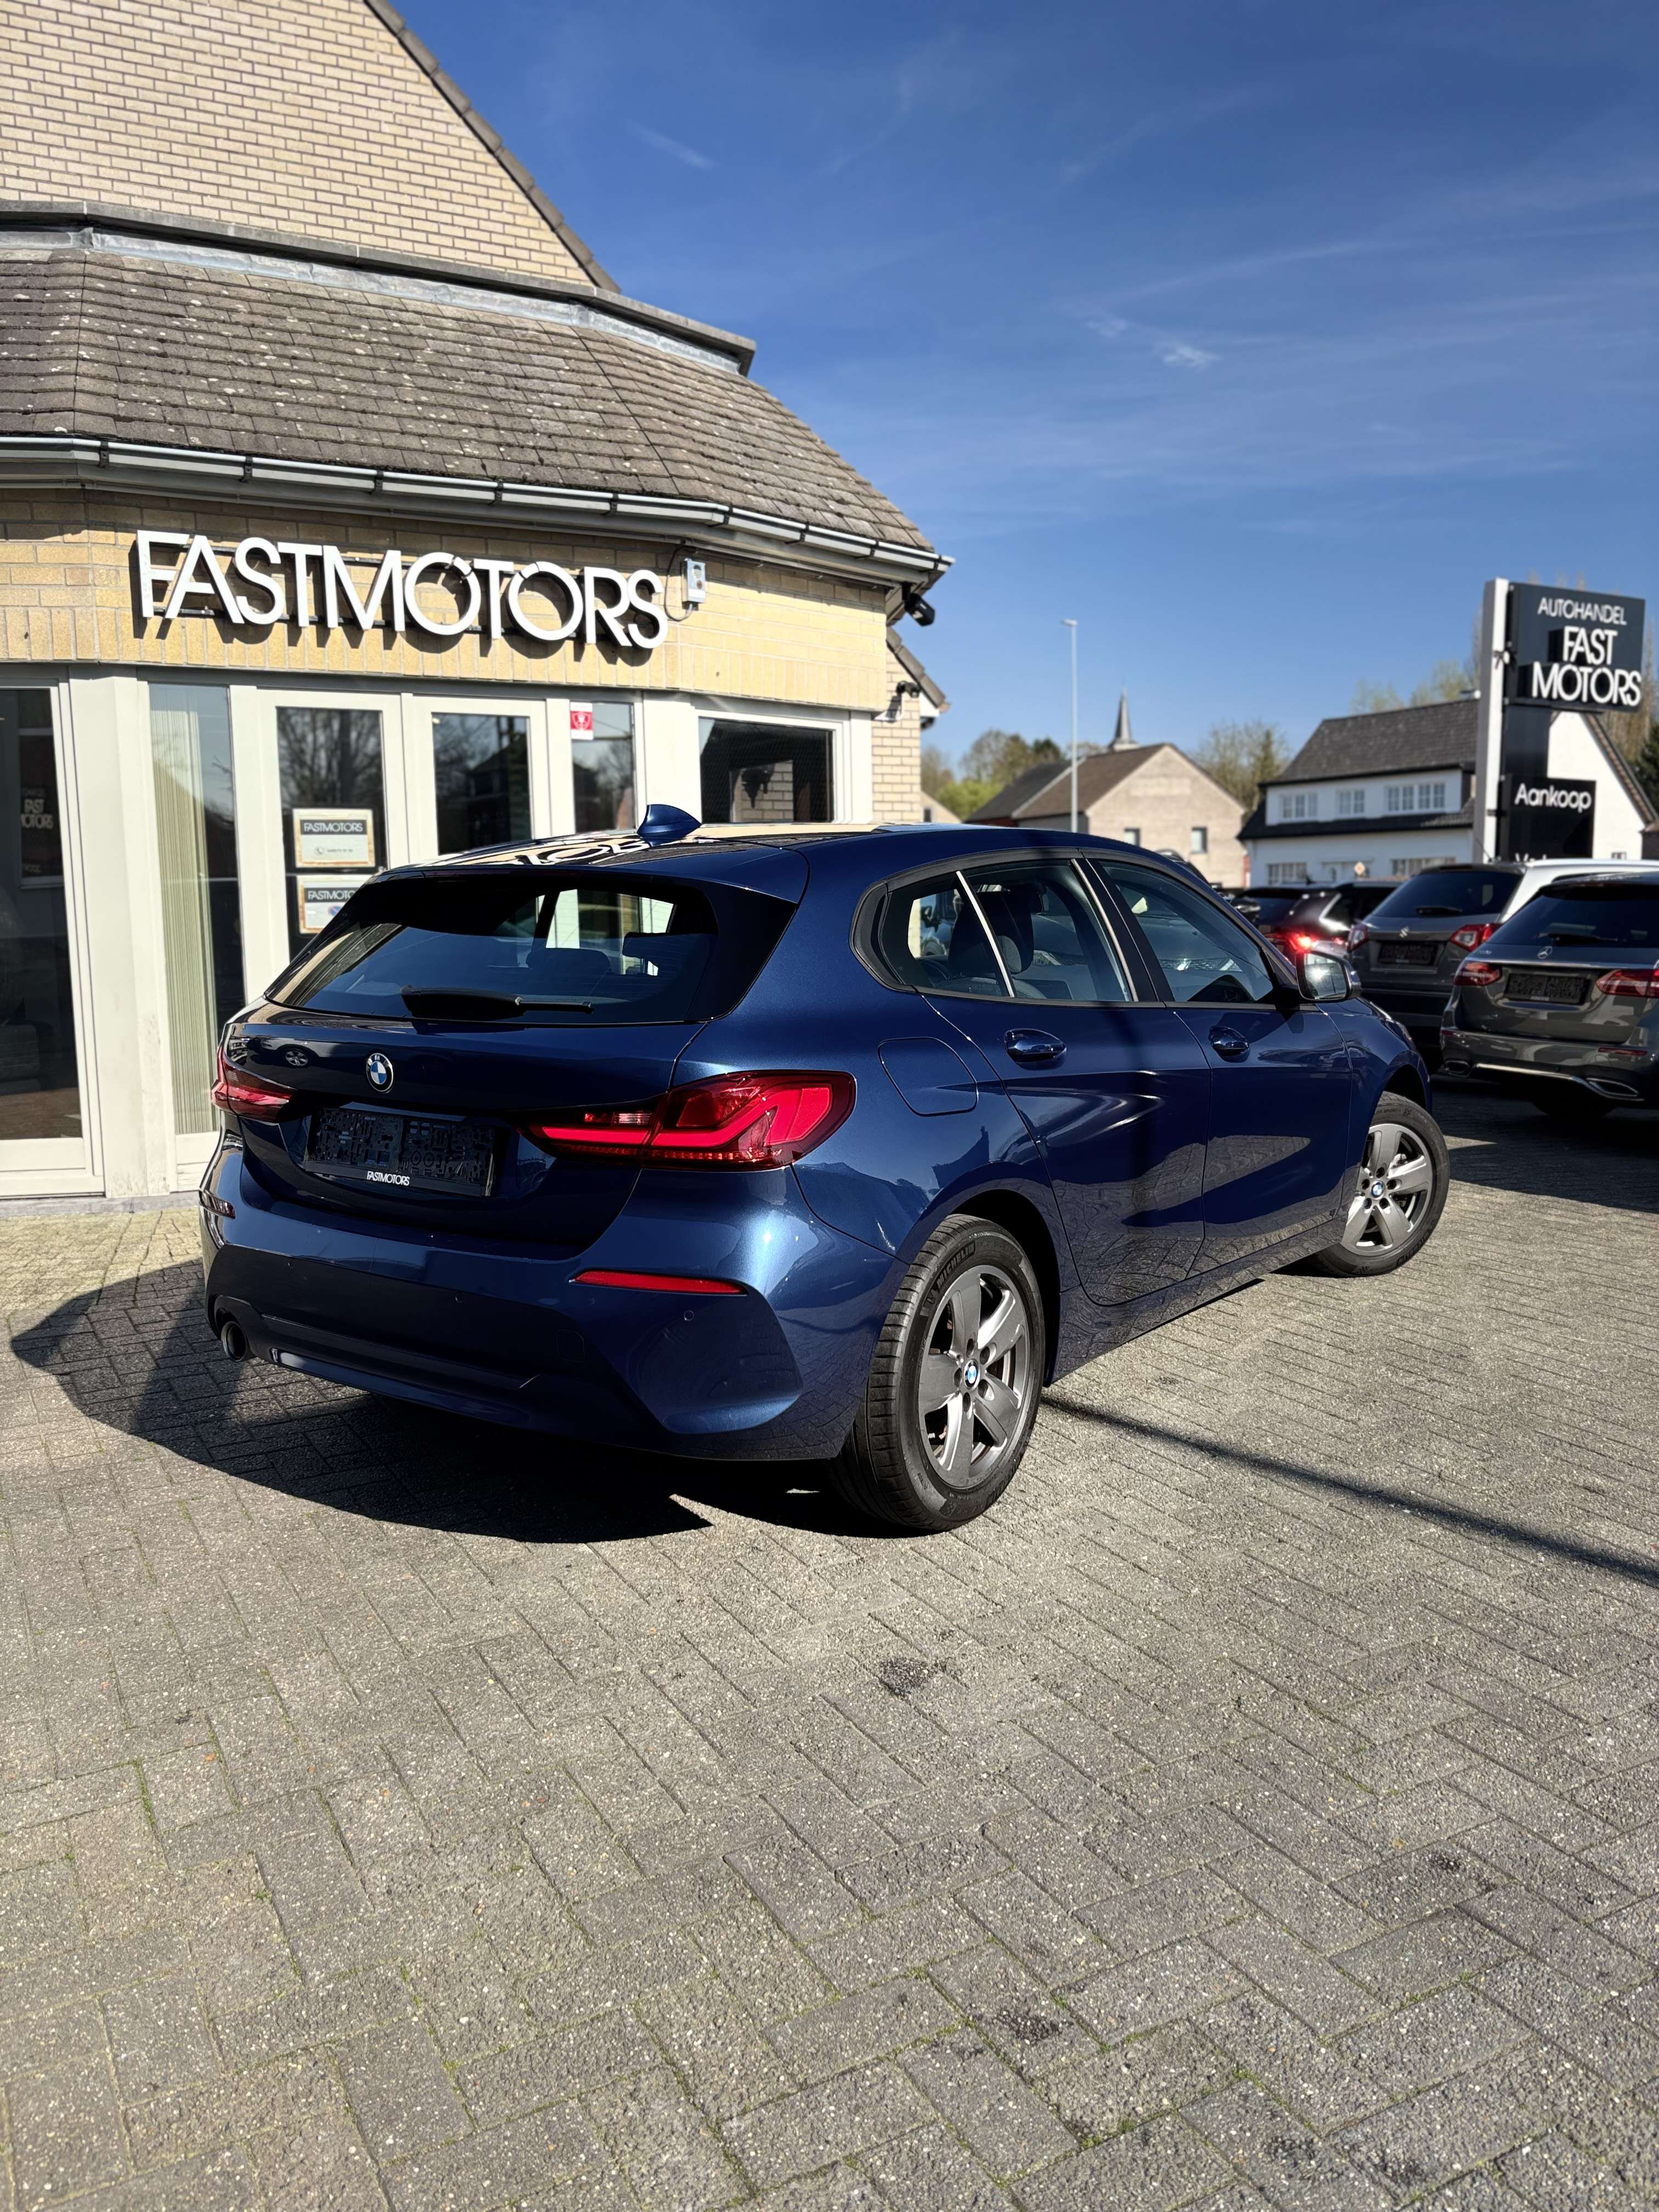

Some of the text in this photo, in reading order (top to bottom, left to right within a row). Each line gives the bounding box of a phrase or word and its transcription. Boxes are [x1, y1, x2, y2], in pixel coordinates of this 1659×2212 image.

[136, 529, 669, 650] FASTMOTORS
[1537, 596, 1628, 625] AUTOHANDEL
[1563, 625, 1618, 665] FAST
[1532, 661, 1641, 706] MOTORS
[1514, 783, 1592, 813] Aankoop
[303, 822, 363, 833] FASTMOTORS
[308, 890, 356, 901] FASTMOTO
[366, 1170, 410, 1186] FASTMOTORS
[936, 1241, 976, 1288] MICHELIN
